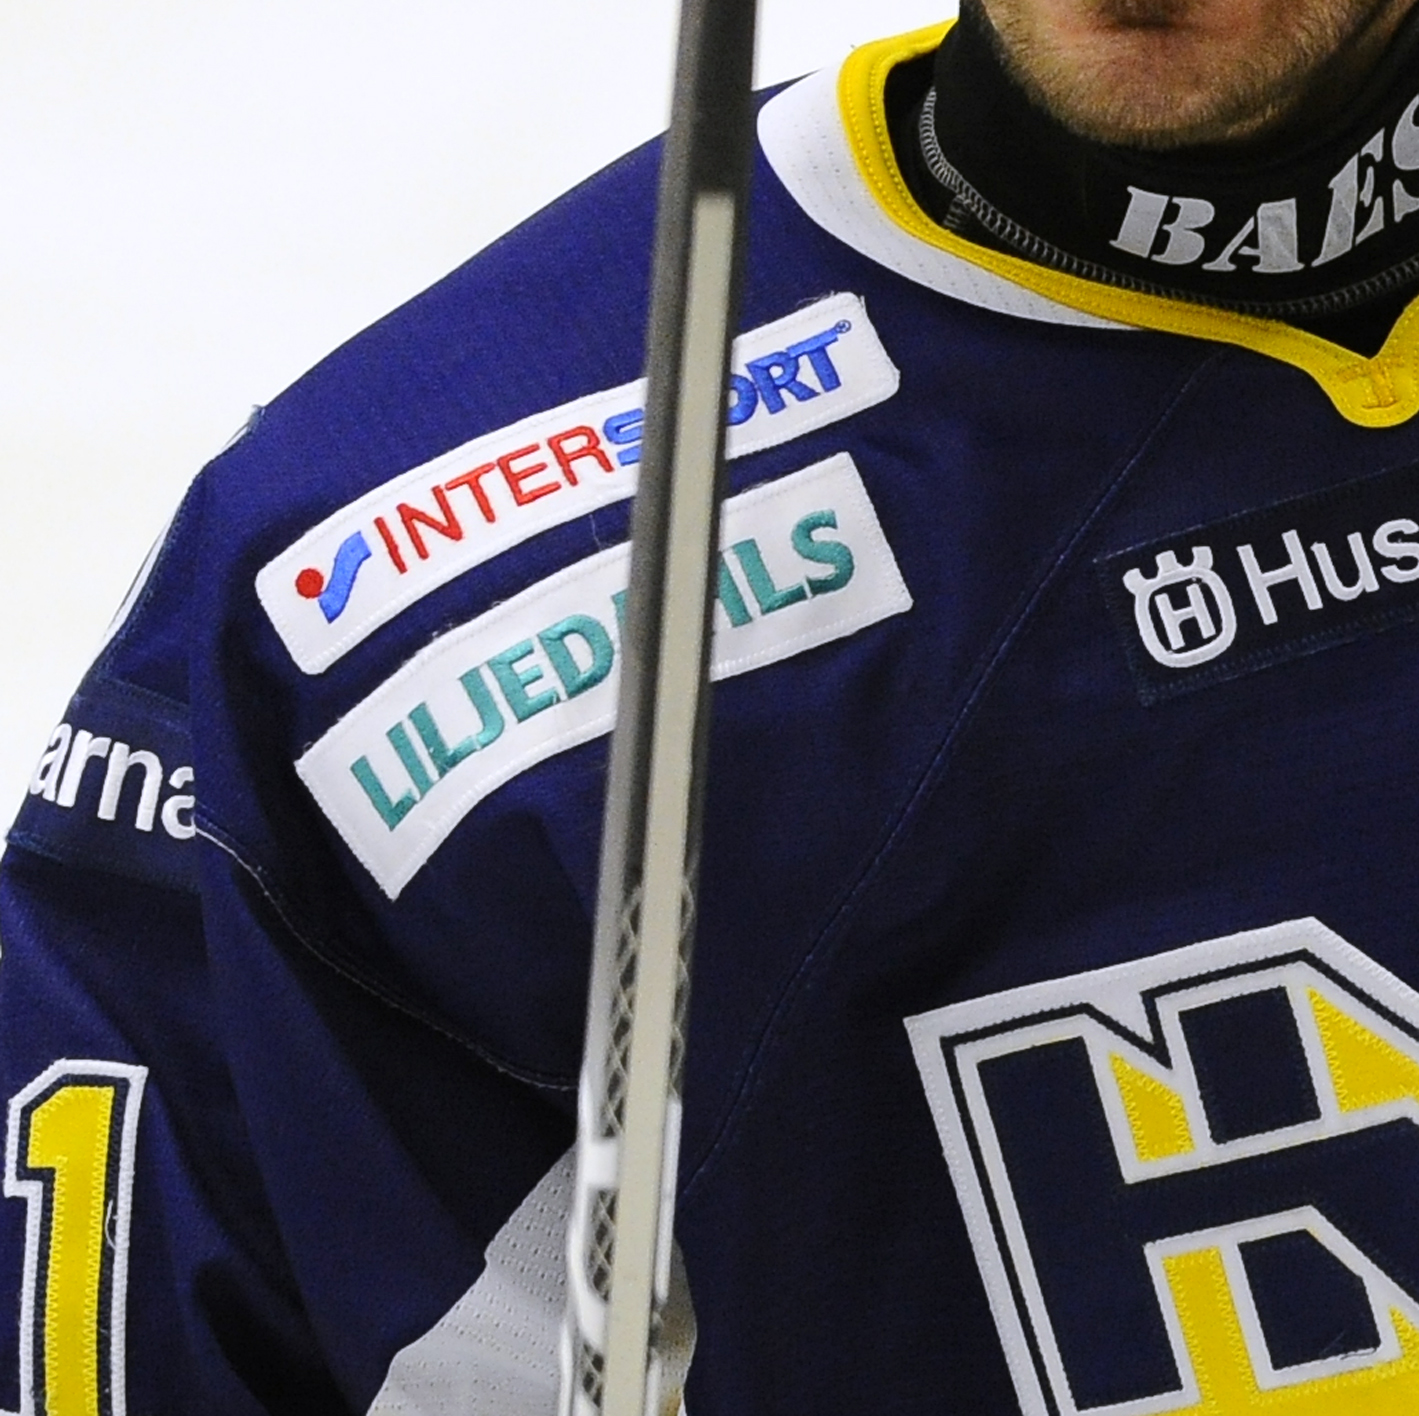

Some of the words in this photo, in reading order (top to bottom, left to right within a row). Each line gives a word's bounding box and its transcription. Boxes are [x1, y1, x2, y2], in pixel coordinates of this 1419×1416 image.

[374, 319, 852, 574] INTERSORT
[349, 508, 855, 833] LILJEDLS
[4, 1057, 148, 1416] 1
